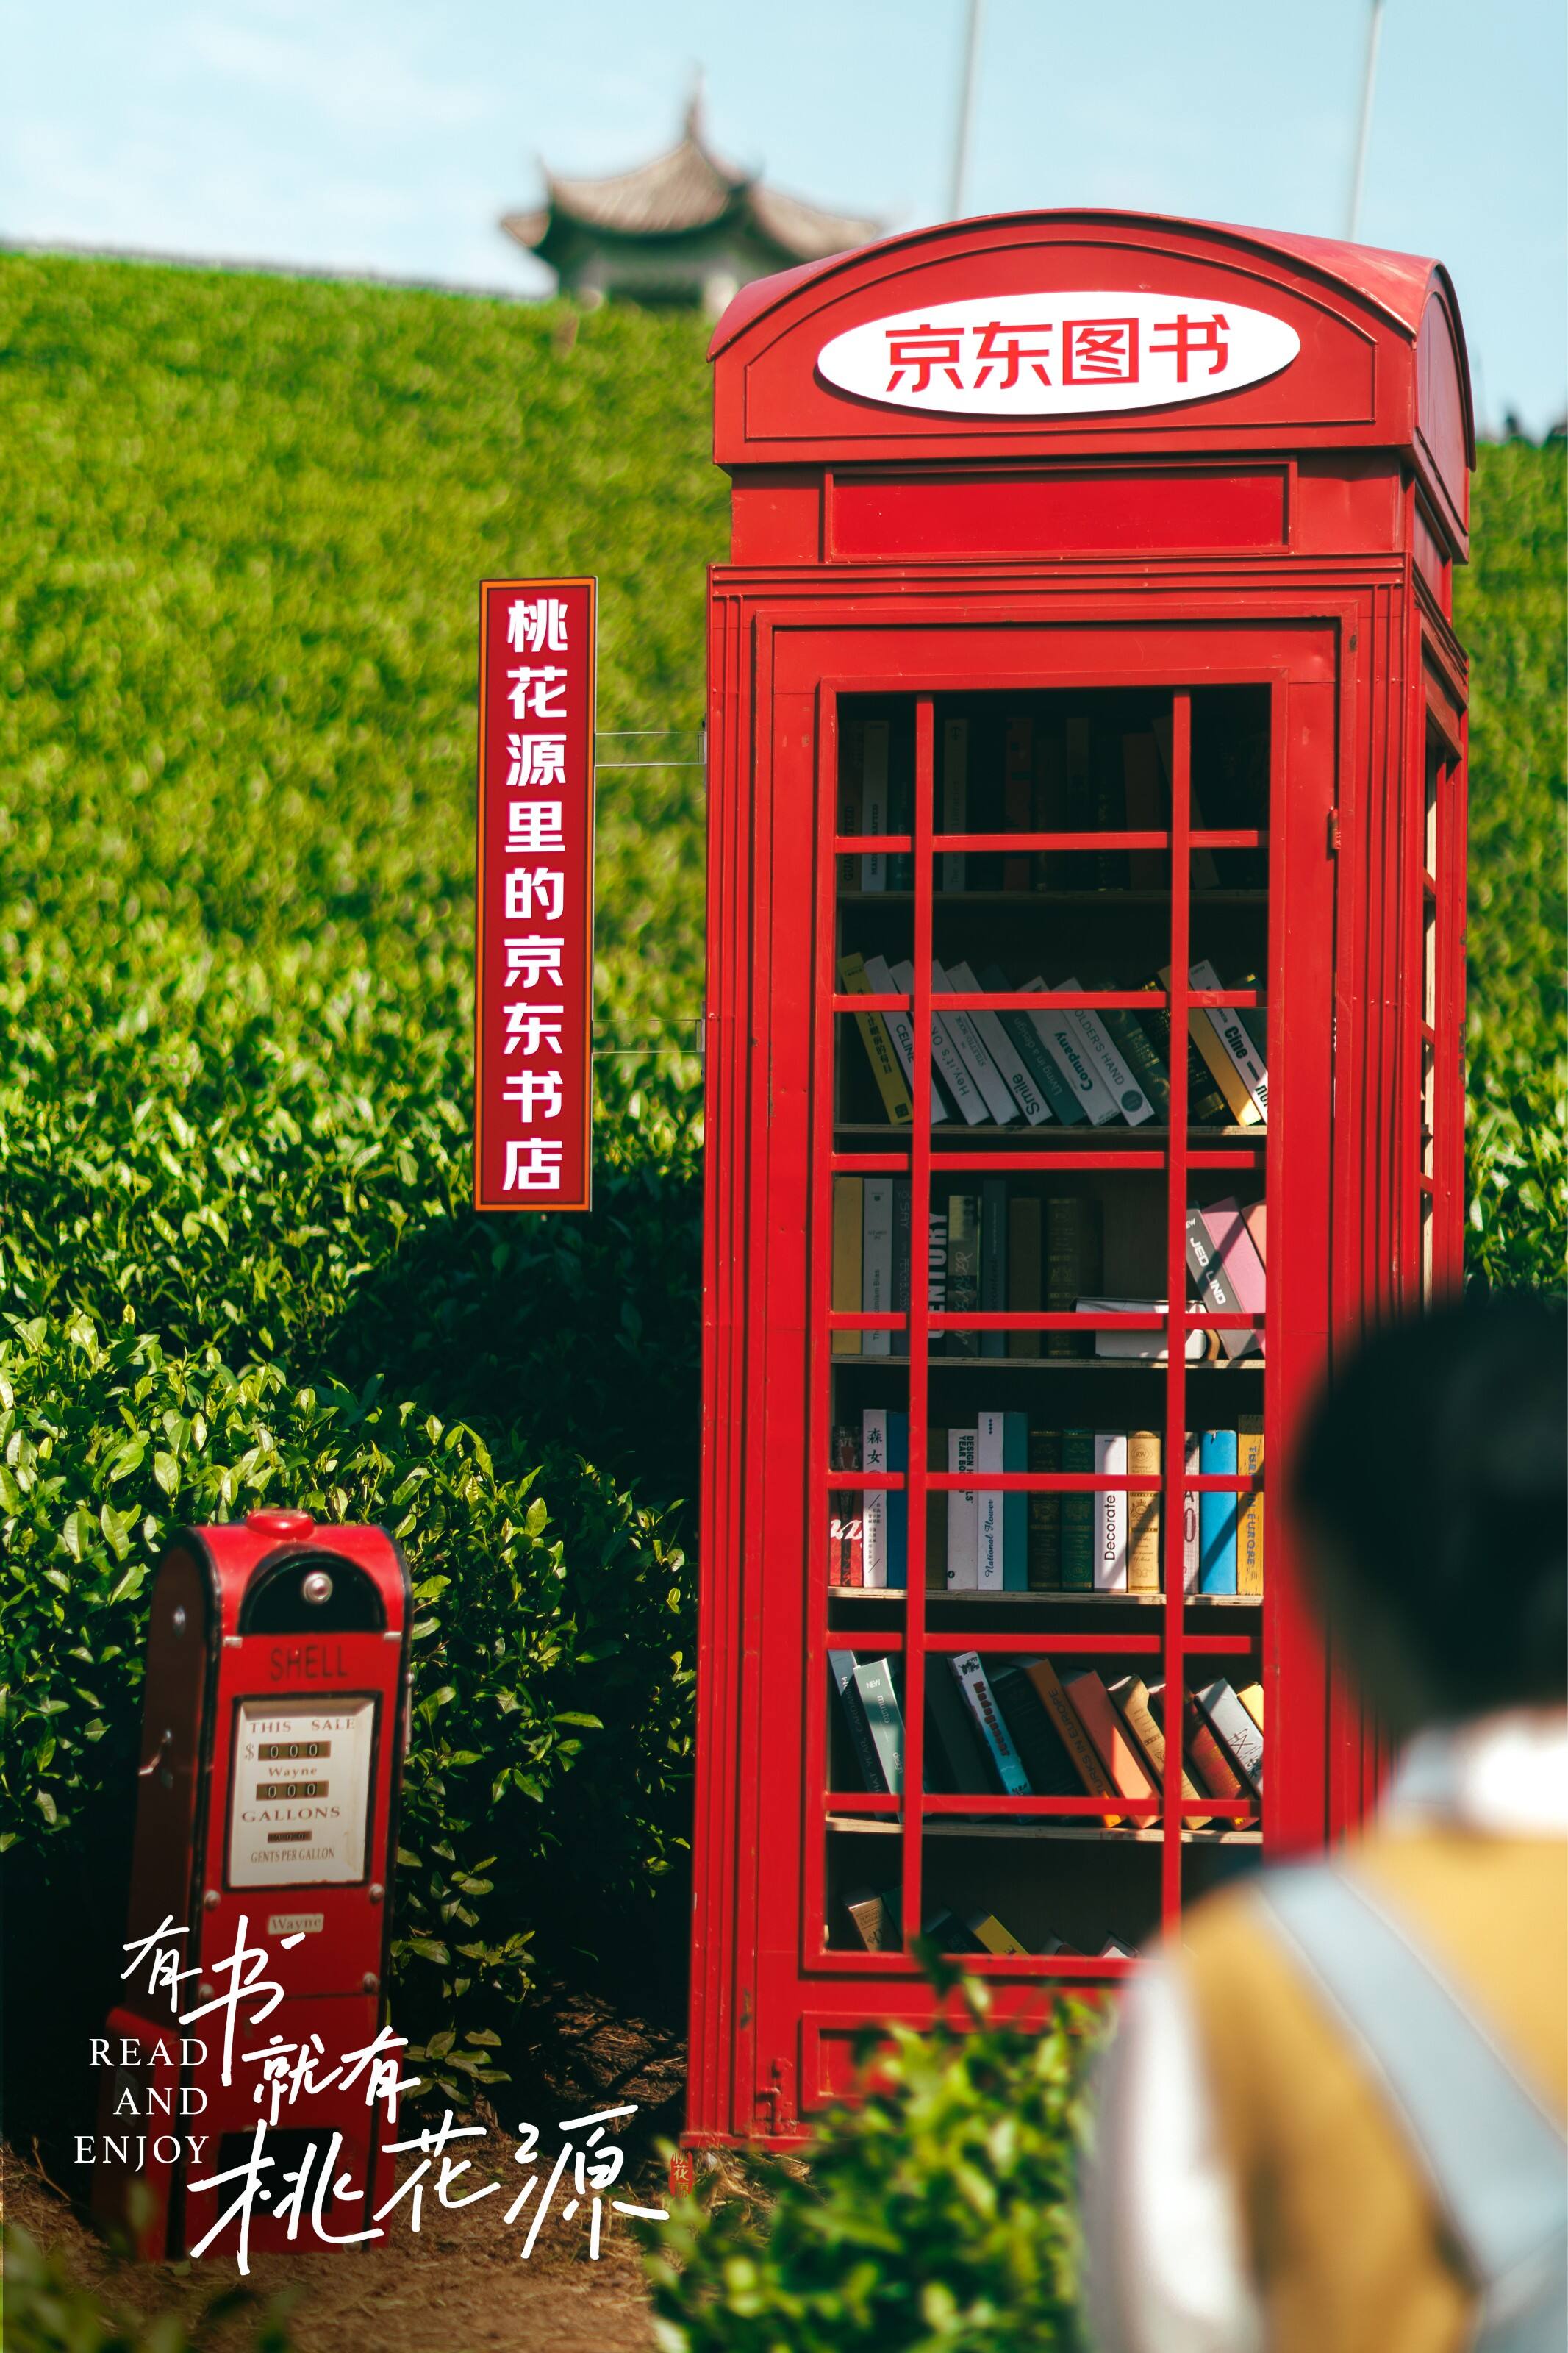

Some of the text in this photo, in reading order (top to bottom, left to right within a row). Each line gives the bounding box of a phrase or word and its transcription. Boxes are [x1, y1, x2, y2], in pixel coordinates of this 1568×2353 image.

[885, 314, 1231, 393] 京东图书
[503, 597, 568, 1191] 桃花源里的京东书店
[896, 1024, 914, 1063] CELINE
[1014, 1018, 1035, 1049] design
[1075, 1010, 1105, 1052] OLDERS
[1102, 1053, 1125, 1085] HAND
[1225, 1026, 1247, 1060] Cine
[1042, 1065, 1063, 1096] Living
[1055, 1032, 1093, 1091] Company
[1012, 1073, 1040, 1115] Smile
[1190, 1238, 1226, 1305] JED LIND
[985, 1499, 994, 1577] National Flower
[1104, 1494, 1116, 1560] Decorate
[1246, 1513, 1256, 1565] EUROPE
[270, 1644, 348, 1681] SHELL
[866, 1679, 881, 1689] NEW
[249, 1718, 355, 1734] THIS SALE
[877, 1696, 890, 1724] muuto
[973, 1681, 1009, 1757] Madagascar
[1049, 1688, 1078, 1739] EUROPE
[268, 1767, 318, 1779] Wayne
[242, 1807, 341, 1823] GALLONS
[282, 1849, 297, 1862] PER
[298, 1846, 335, 1860] GALLON
[272, 1918, 321, 1931] Wayne
